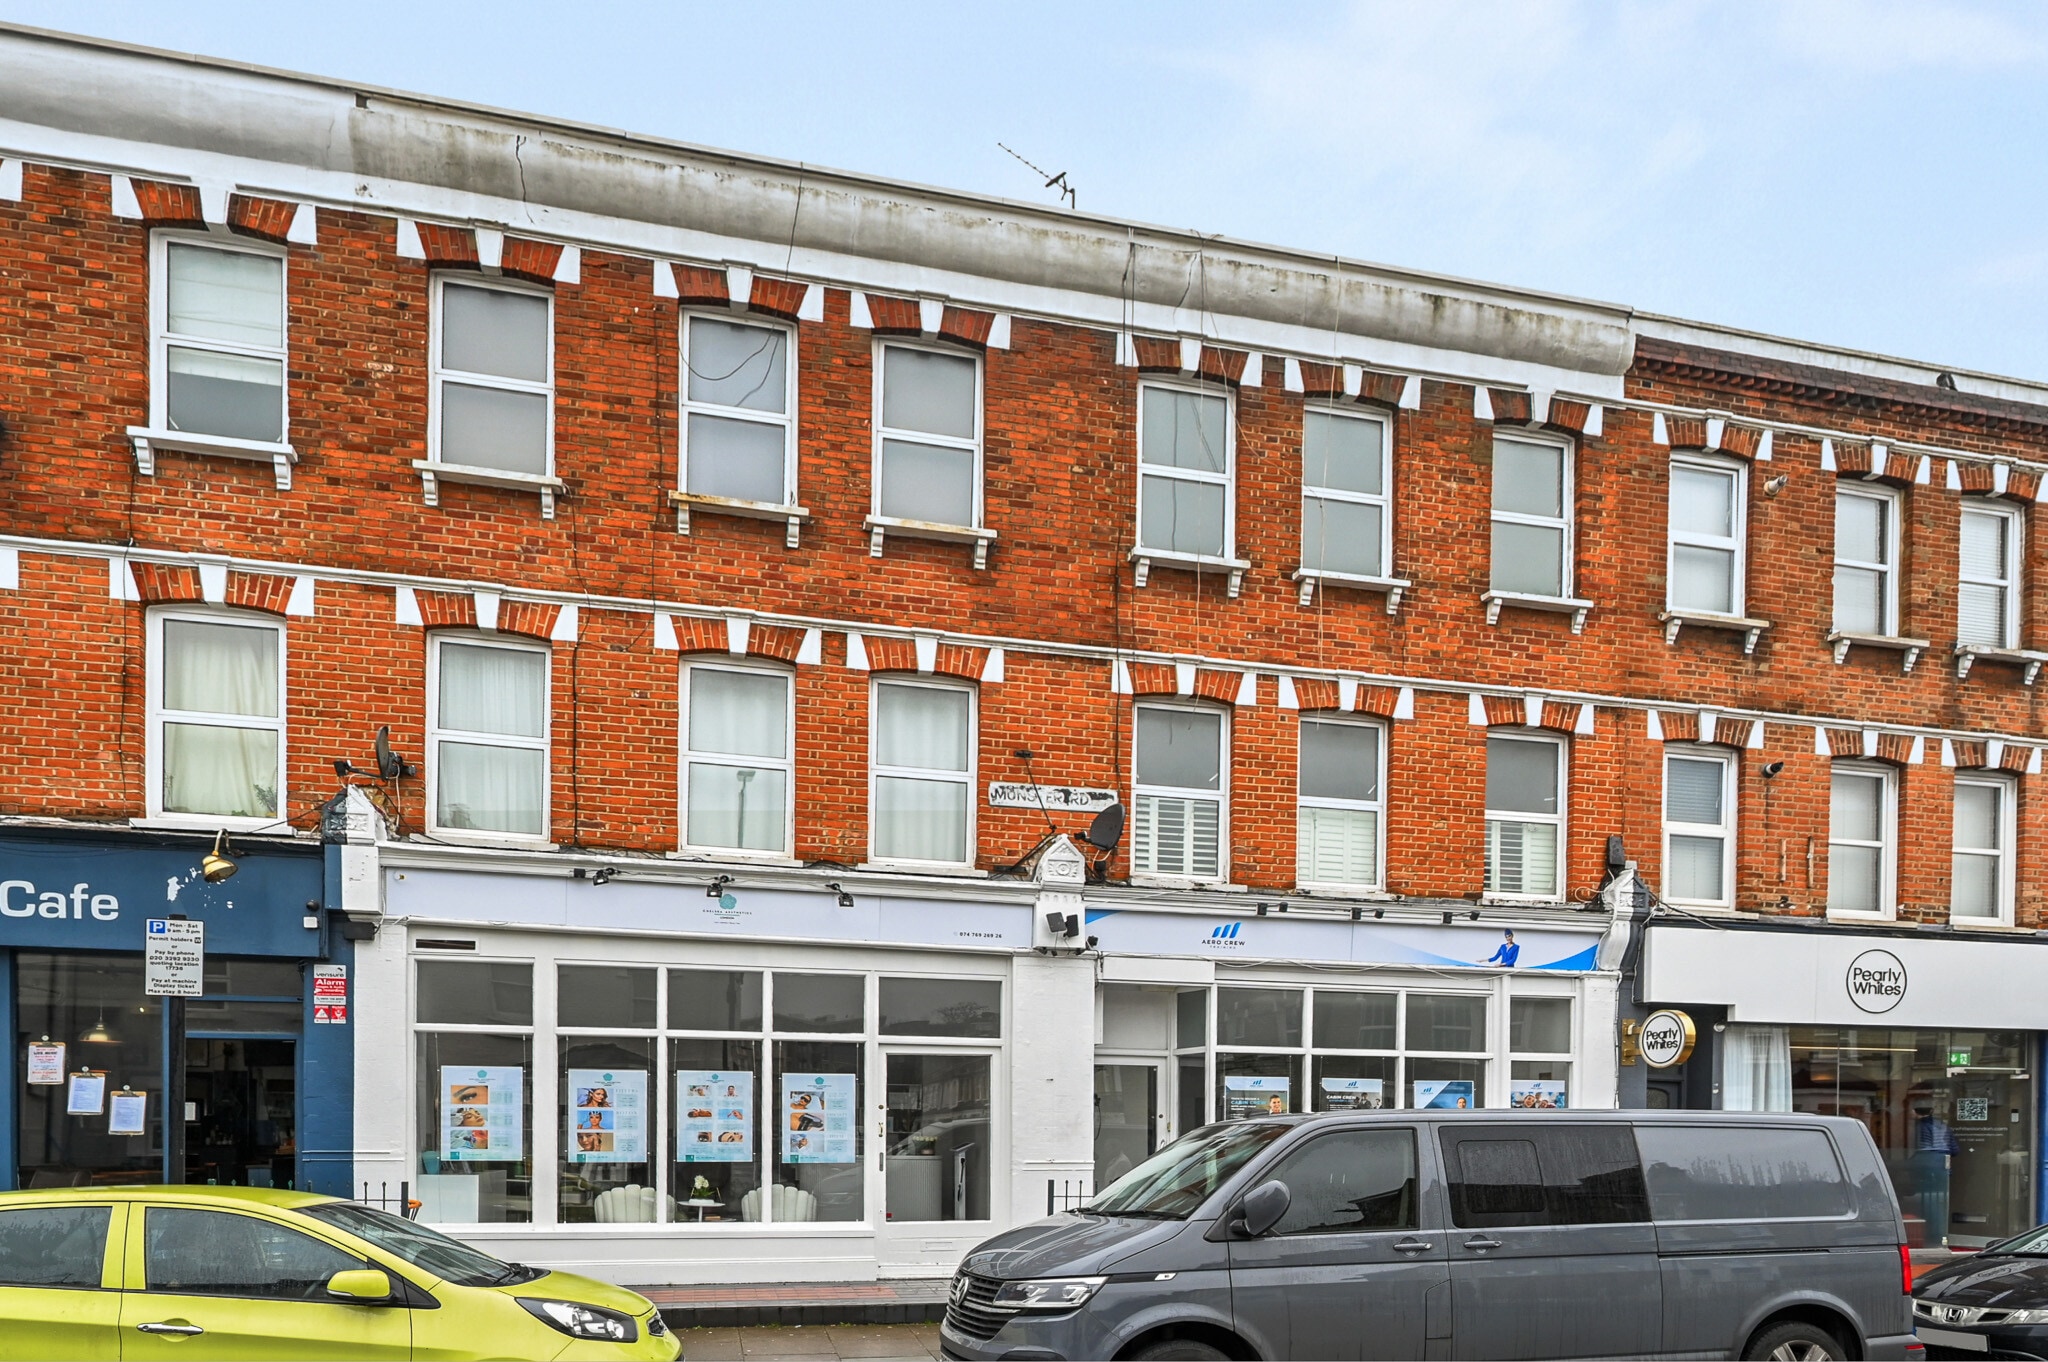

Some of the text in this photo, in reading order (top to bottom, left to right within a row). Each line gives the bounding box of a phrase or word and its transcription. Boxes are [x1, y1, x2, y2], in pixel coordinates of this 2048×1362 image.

[993, 787, 1063, 804] MUNSER
[0, 880, 119, 921] Cafe
[153, 922, 163, 932] P
[1853, 967, 1902, 985] Pearly
[1853, 981, 1902, 996] Whites
[1646, 1028, 1678, 1040] Pearly
[1646, 1040, 1678, 1050] Whites
